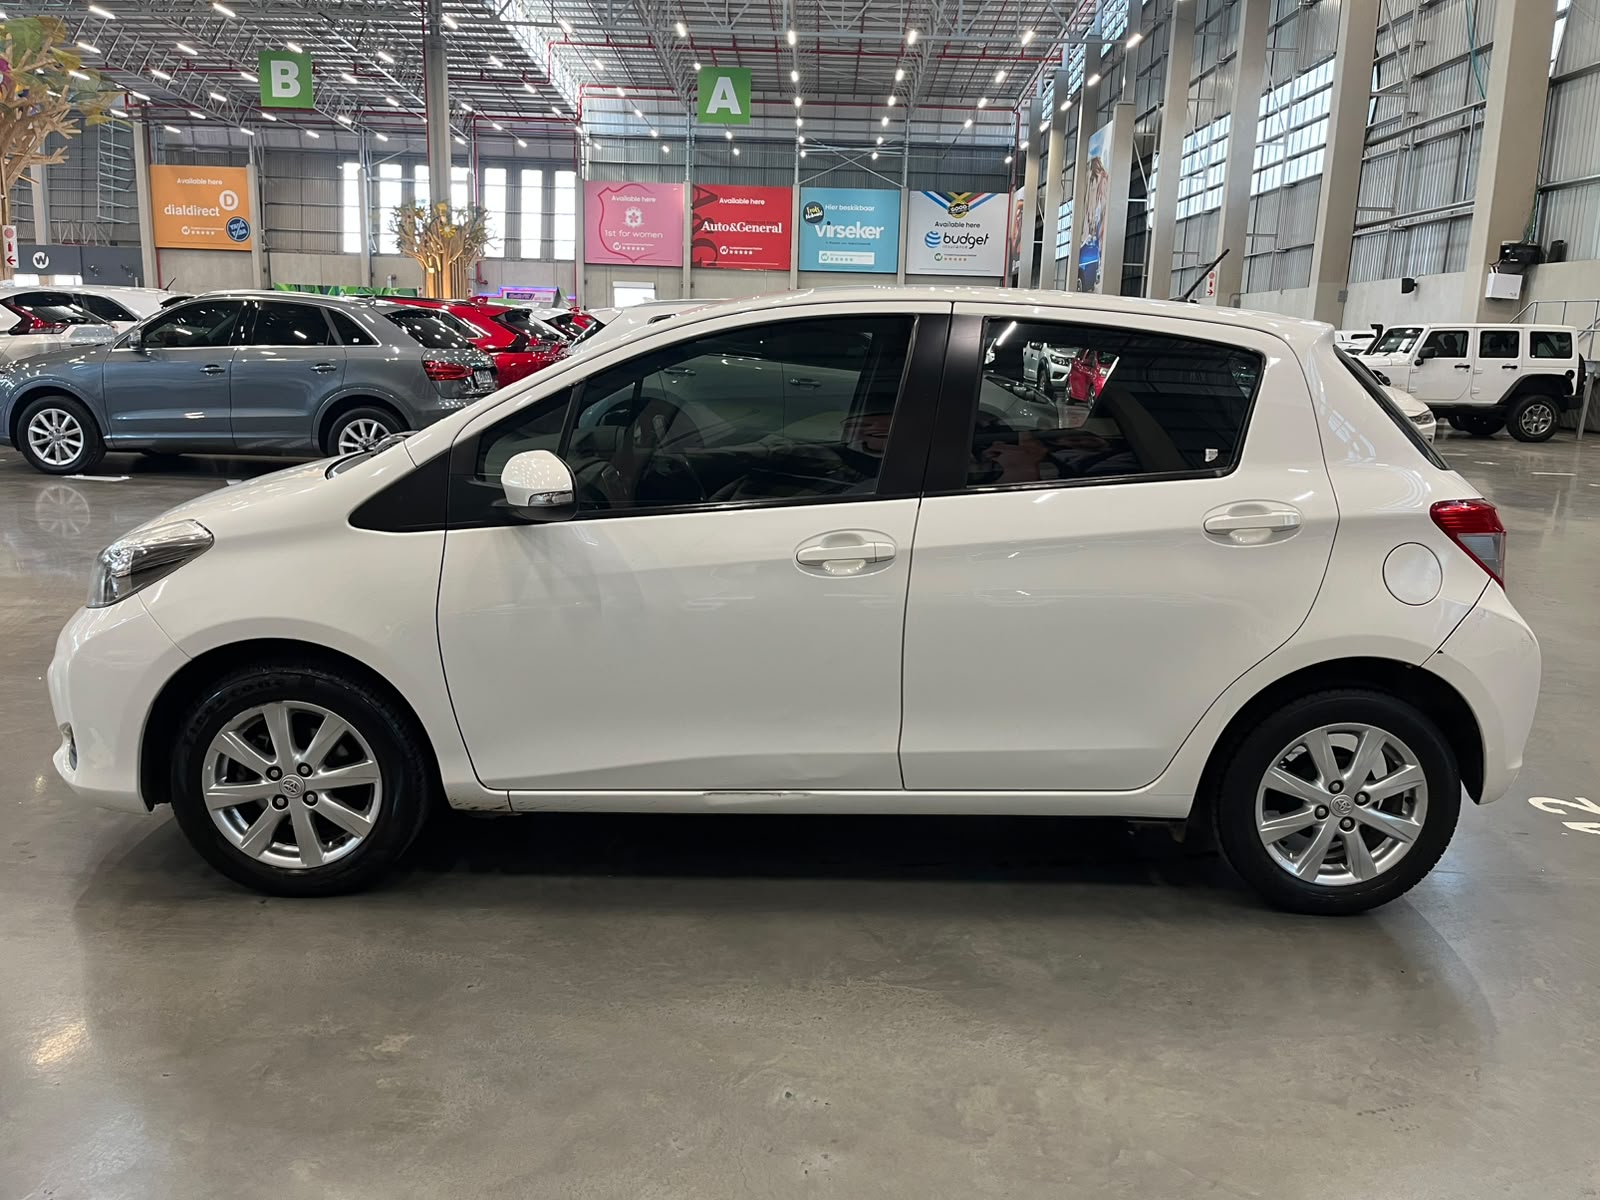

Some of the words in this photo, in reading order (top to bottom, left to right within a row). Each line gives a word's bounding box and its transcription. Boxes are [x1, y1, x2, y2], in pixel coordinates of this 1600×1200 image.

[270, 60, 301, 98] B
[706, 76, 742, 115] A
[641, 195, 656, 203] here
[719, 197, 749, 205] Available
[750, 198, 765, 206] here
[164, 204, 220, 217] dialdirect
[838, 204, 875, 212] beskikbaar
[701, 220, 783, 234] Auto&General
[814, 221, 885, 239] virseker
[604, 229, 616, 237] 1st
[619, 229, 631, 237] for
[632, 231, 663, 239] women
[943, 232, 990, 250] budget
